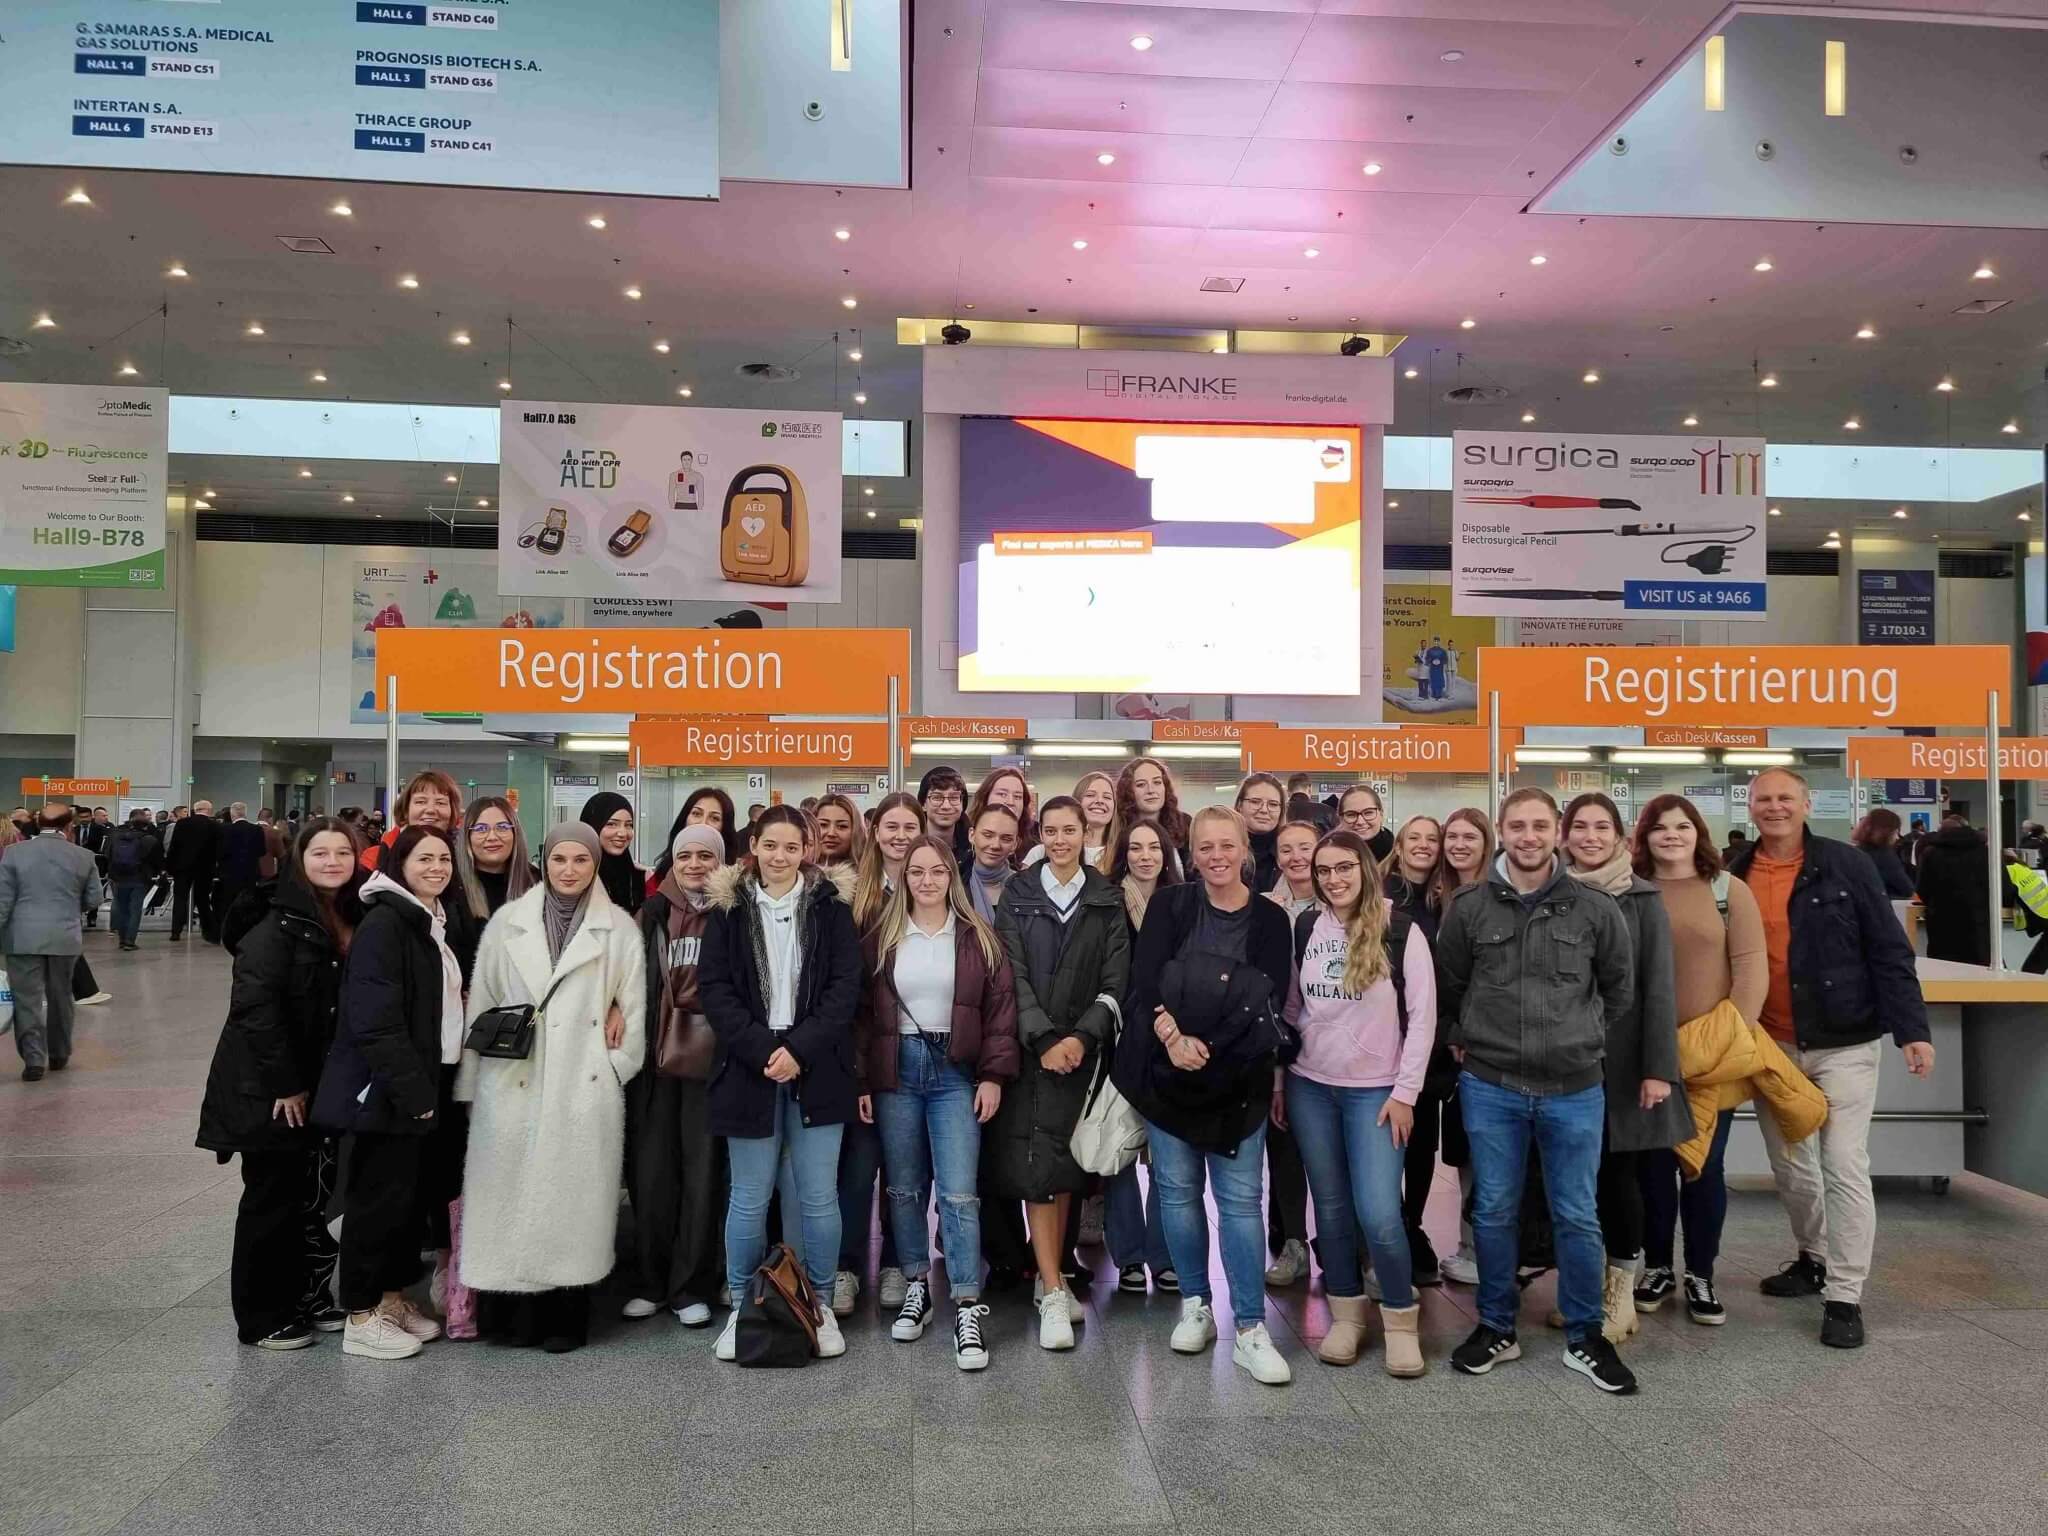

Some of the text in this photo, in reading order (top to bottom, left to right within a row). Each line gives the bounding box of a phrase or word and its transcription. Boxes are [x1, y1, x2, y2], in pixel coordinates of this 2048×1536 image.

[373, 8, 413, 20] HALL 6
[432, 12, 495, 24] STAND C40
[75, 22, 274, 43] G. SAMARAS S.A. MEDICAL
[76, 37, 199, 54] GAS SOLUTIONS
[87, 59, 134, 71] HALL 14
[356, 50, 543, 72] PROGNOSIS BIOTECH S.A.
[151, 62, 215, 75] STAND C51
[371, 71, 411, 83] HALL 3
[430, 75, 493, 88] STAND G36
[73, 99, 183, 115] INTERTAN S.A.
[89, 121, 131, 133] HALL 6
[355, 113, 472, 131] THRACE GROUP
[150, 125, 213, 137] STAND E13
[371, 135, 411, 147] HALL 5
[430, 139, 492, 151] STAND C41
[1121, 376, 1238, 395] FRANKE
[523, 413, 576, 424] Hall7.0 A36
[17, 438, 49, 459] 3D
[1463, 441, 1619, 472] surgica
[582, 459, 600, 467] with
[744, 503, 766, 512] AED
[47, 512, 145, 522] Welcome to Our Booth:
[1462, 523, 1511, 534] Disposable
[33, 527, 145, 547] Hall9-B78
[1462, 535, 1557, 547] Electrosurgical Pencil
[363, 568, 389, 577] URIT
[1383, 597, 1437, 606] irst Choice
[1639, 589, 1751, 605] VISIT US at 9A66
[593, 608, 673, 618] anytime, anywhere
[1393, 618, 1427, 627] Yours?
[1521, 621, 1624, 631] INNOVATE THE FUTURE
[1881, 625, 1927, 636] 17D10-1
[500, 639, 783, 703] Registration
[1583, 656, 1900, 717] Registrierung
[910, 721, 1016, 735] Cash Desk/Kassen
[1163, 725, 1190, 737] Cash
[1655, 731, 1757, 745] Cash Desk/Kassen
[687, 727, 853, 762] Registrierung
[1304, 733, 1451, 767] Registration
[1911, 742, 2048, 775] Registatio
[68, 781, 109, 792] Control
[618, 775, 634, 787] 60
[749, 776, 763, 788] 61
[1373, 783, 1387, 794] 66
[1613, 786, 1627, 798] 68
[1733, 788, 1747, 799] 69
[1304, 940, 1349, 961] UNIVER
